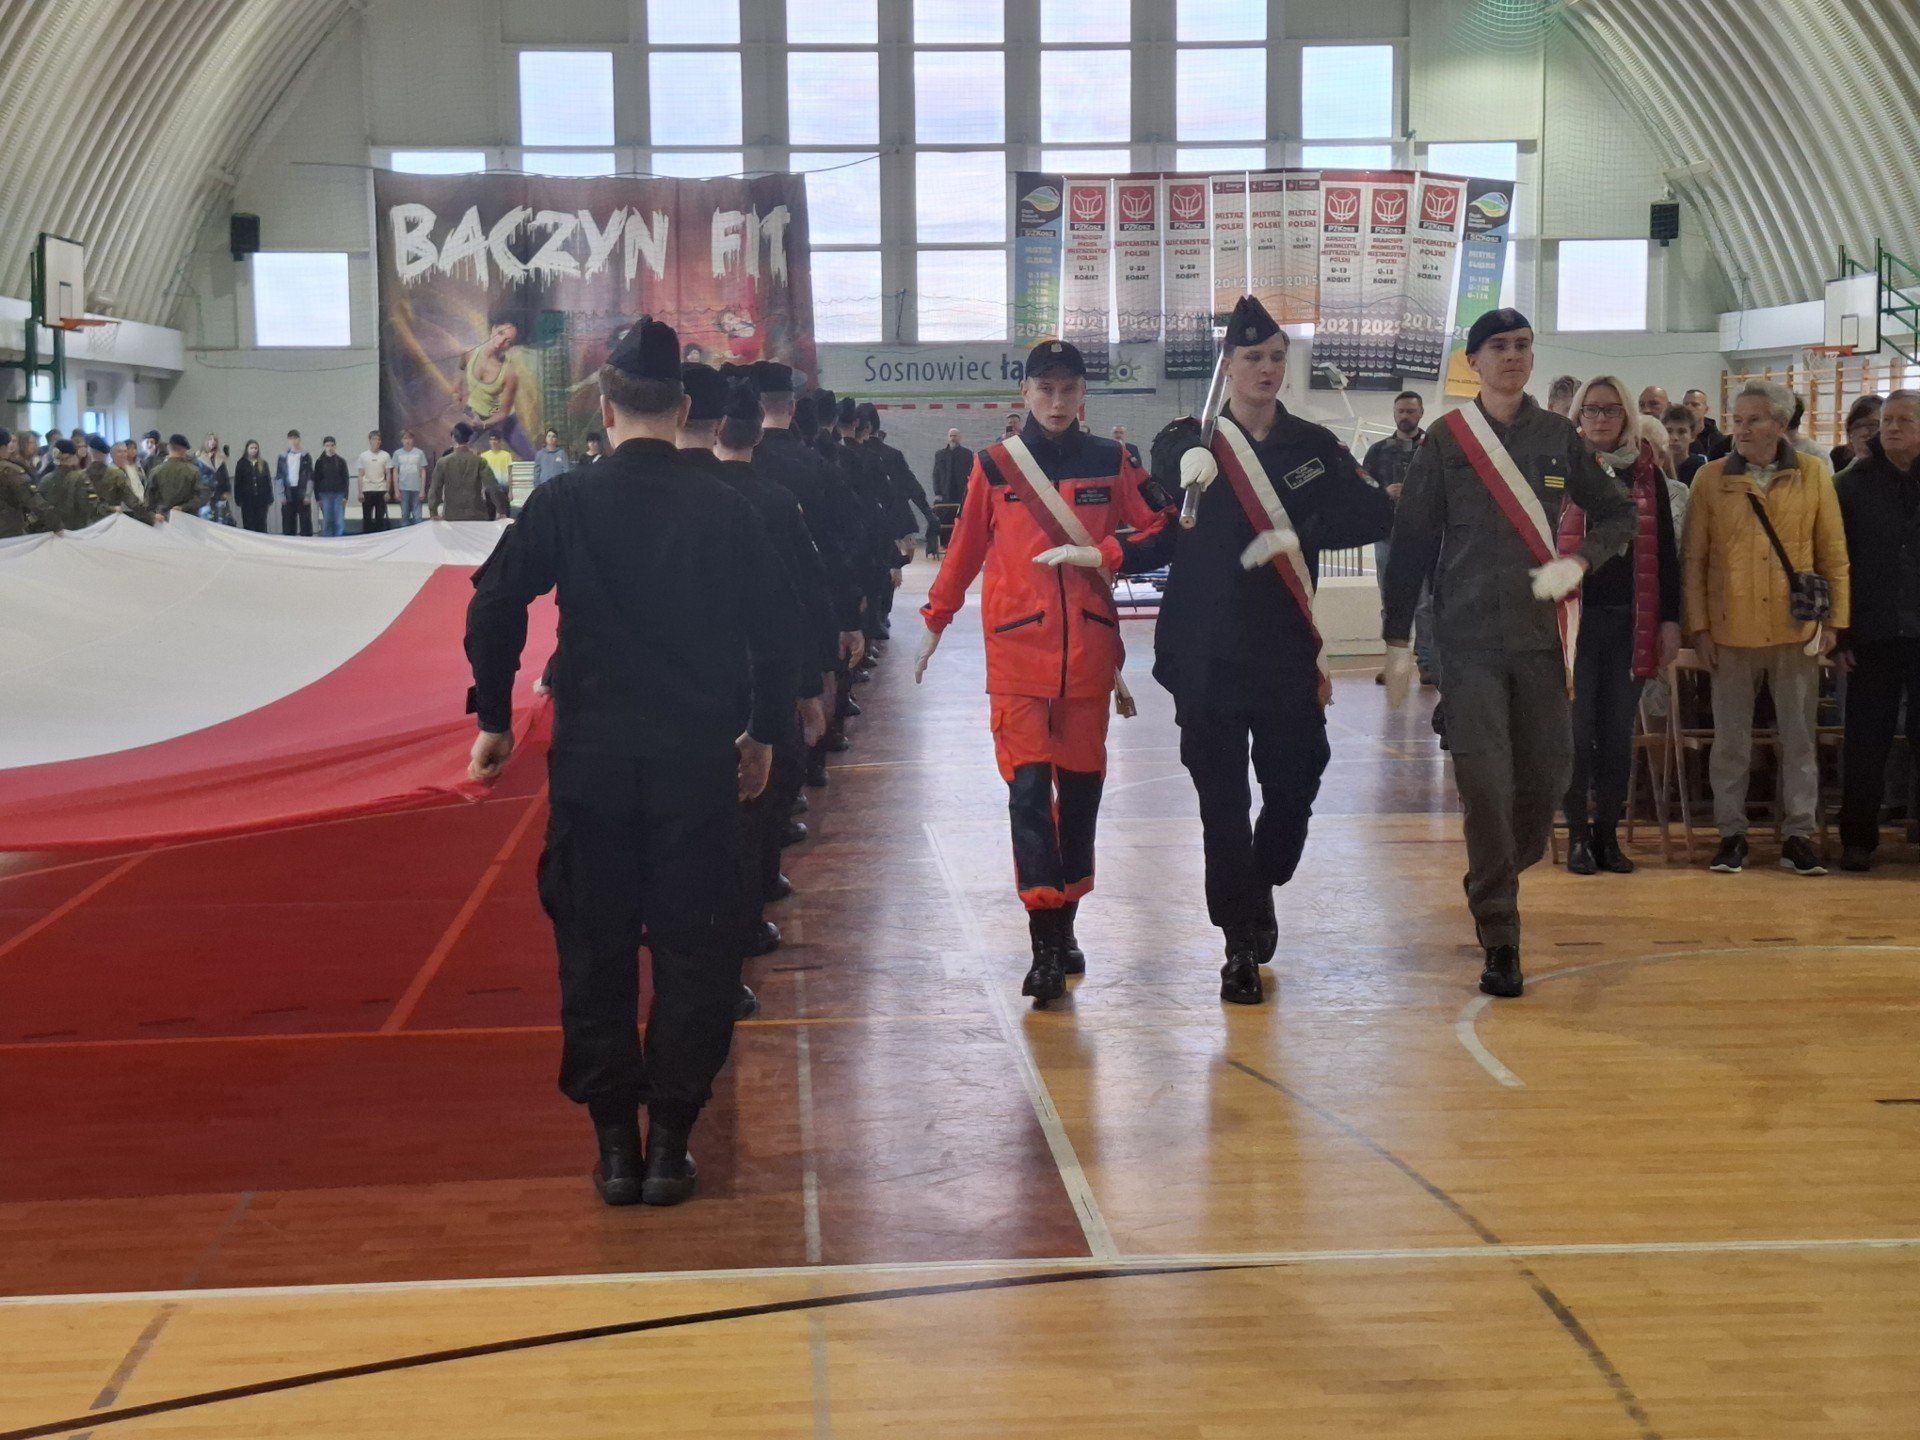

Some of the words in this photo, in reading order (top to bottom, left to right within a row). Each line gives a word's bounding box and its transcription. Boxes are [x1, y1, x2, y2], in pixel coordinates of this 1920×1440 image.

[1253, 221, 1281, 229] POLSKI
[390, 203, 669, 291] BACZYN
[711, 203, 790, 288] FIT
[1165, 238, 1209, 246] WICEMISTRZ
[1413, 237, 1456, 248] WICEMISTRZ
[1420, 249, 1446, 257] POLSKI
[1215, 277, 1247, 289] 2012
[1016, 323, 1057, 336] 2021
[1316, 318, 1360, 335] 2021
[1453, 326, 1470, 340] 20
[865, 355, 991, 383] Sosnowiec
